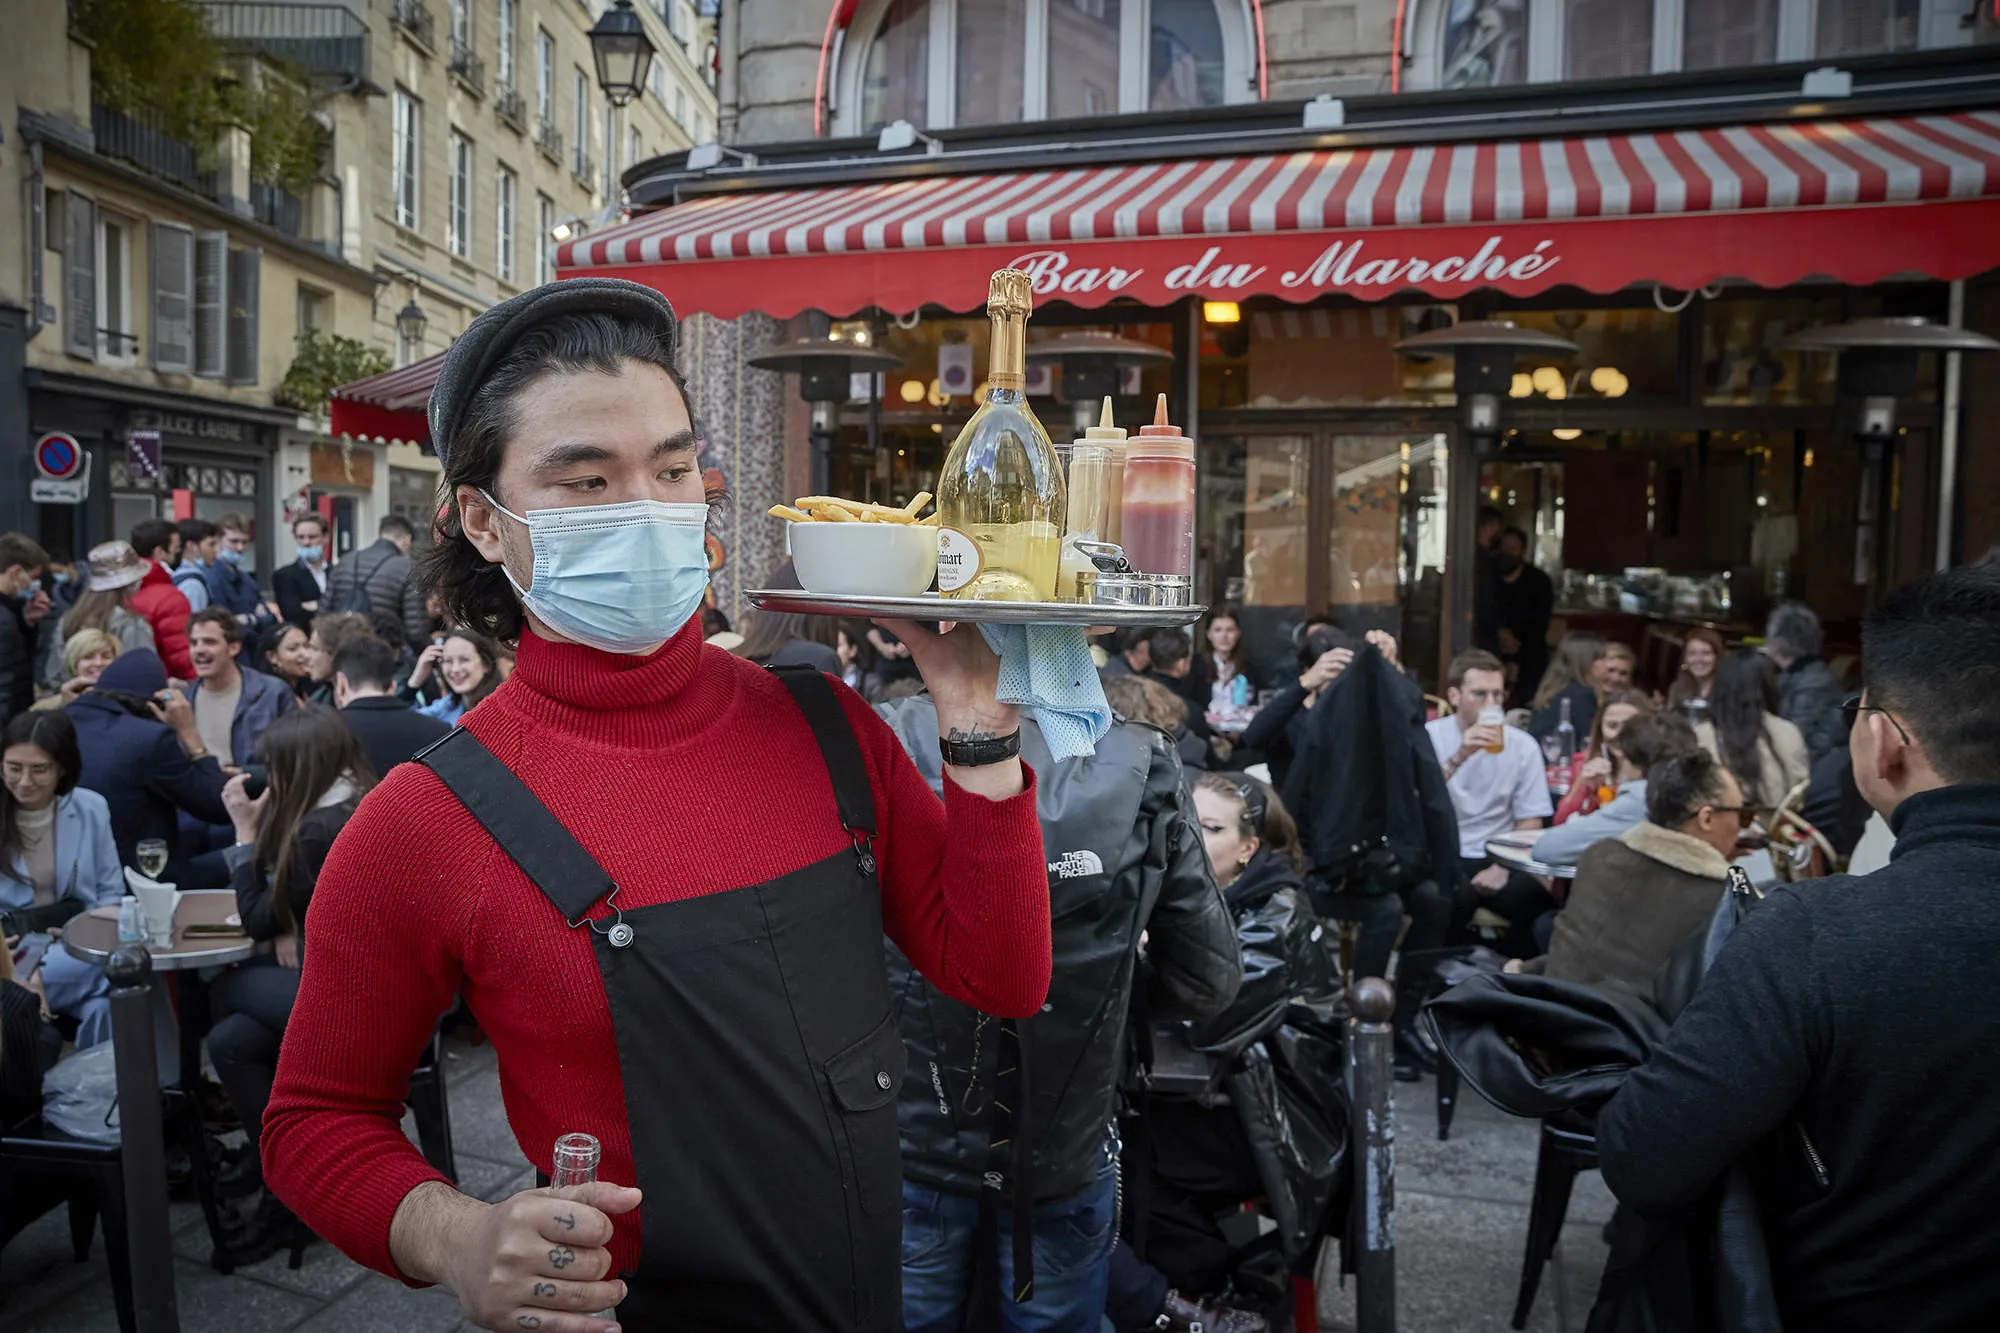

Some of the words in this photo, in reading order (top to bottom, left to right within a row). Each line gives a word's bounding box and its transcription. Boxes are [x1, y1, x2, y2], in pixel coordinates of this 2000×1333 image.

[1007, 250, 1144, 294] Bar
[1163, 246, 1268, 288] du
[1280, 236, 1561, 288] Marché
[1062, 851, 1084, 861] THE
[1048, 860, 1084, 872] NORTH
[1059, 868, 1086, 879] FACE
